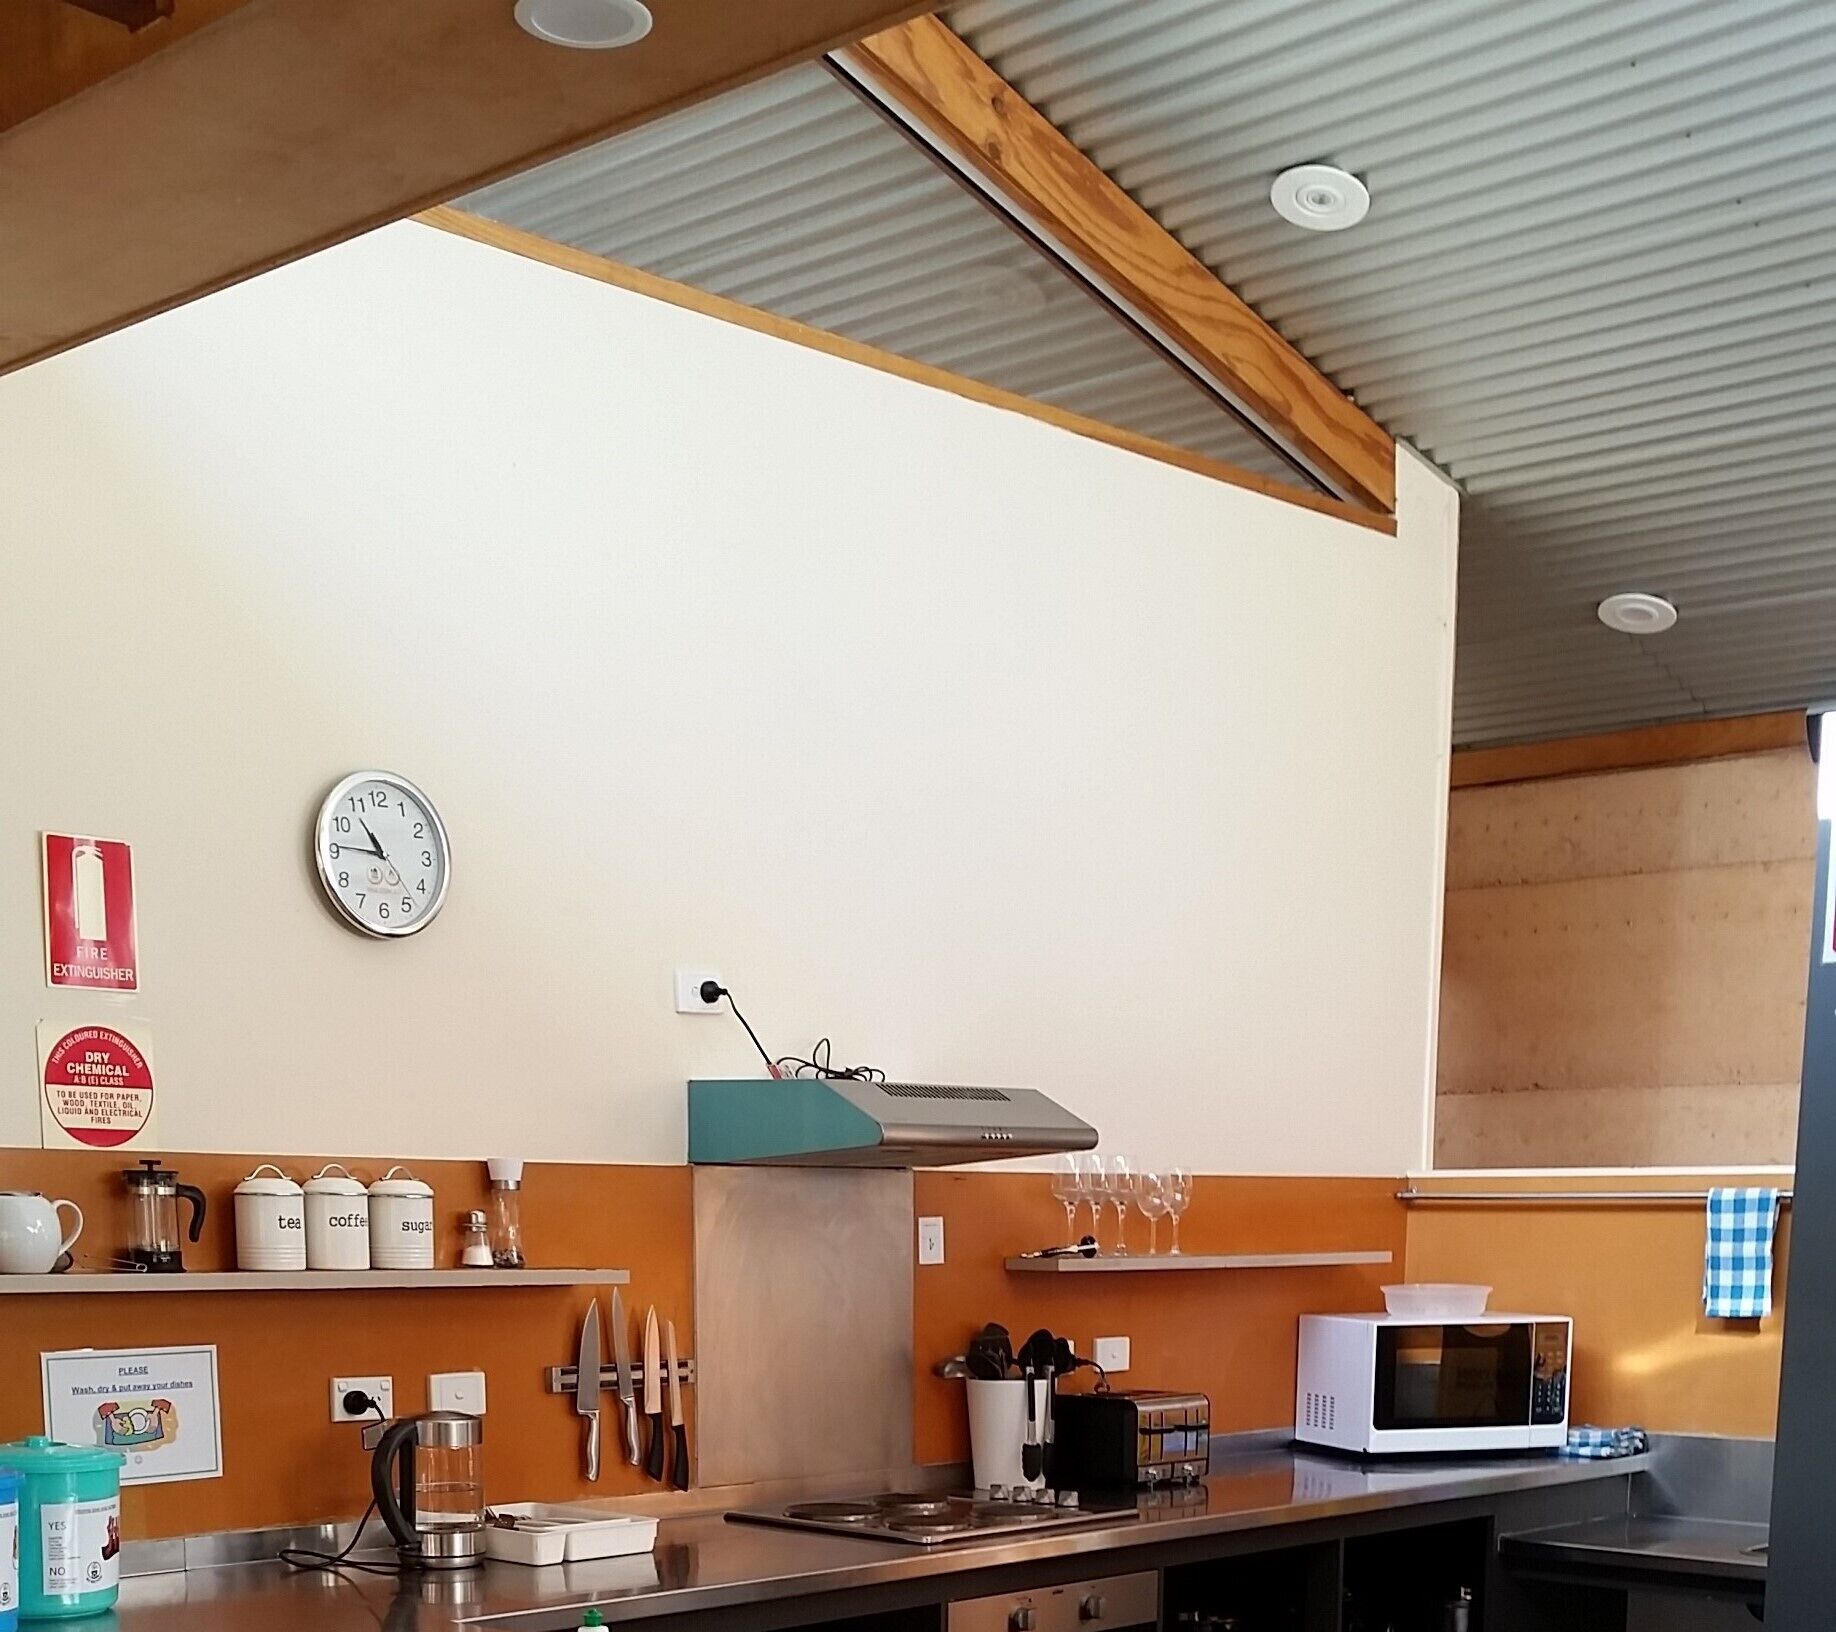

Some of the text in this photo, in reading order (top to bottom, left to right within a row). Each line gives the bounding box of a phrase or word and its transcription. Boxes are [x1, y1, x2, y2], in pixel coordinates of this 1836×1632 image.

[348, 797, 366, 812] 11
[369, 790, 388, 808] 12
[397, 802, 406, 818] 1
[333, 816, 350, 832] 10
[413, 822, 424, 839] 2
[329, 842, 340, 860] 9
[421, 850, 432, 868] 3
[338, 872, 349, 888] 8
[416, 878, 426, 894] 4
[356, 892, 366, 909] 7
[401, 896, 412, 913] 5
[379, 902, 390, 919] 6
[76, 946, 108, 960] FIRE
[53, 963, 134, 981] EXTINGUISHER
[52, 1031, 143, 1069] THIS COLOURED EXTINGUISHER
[85, 1052, 110, 1063] DRY
[66, 1062, 130, 1076] CHEMICAL
[100, 1076, 124, 1086] CLASS
[57, 1090, 66, 1098] TO
[79, 1092, 98, 1100] USED
[100, 1092, 114, 1100] FOR
[84, 1108, 98, 1116] AND
[102, 1110, 142, 1118] ELECTRICAL
[278, 1214, 302, 1230] tea
[118, 1366, 148, 1376] PLEASE
[120, 1384, 132, 1392] put
[152, 1382, 168, 1390] your
[170, 1380, 193, 1388] dishes
[48, 1522, 67, 1530] YES
[50, 1567, 66, 1576] NO
